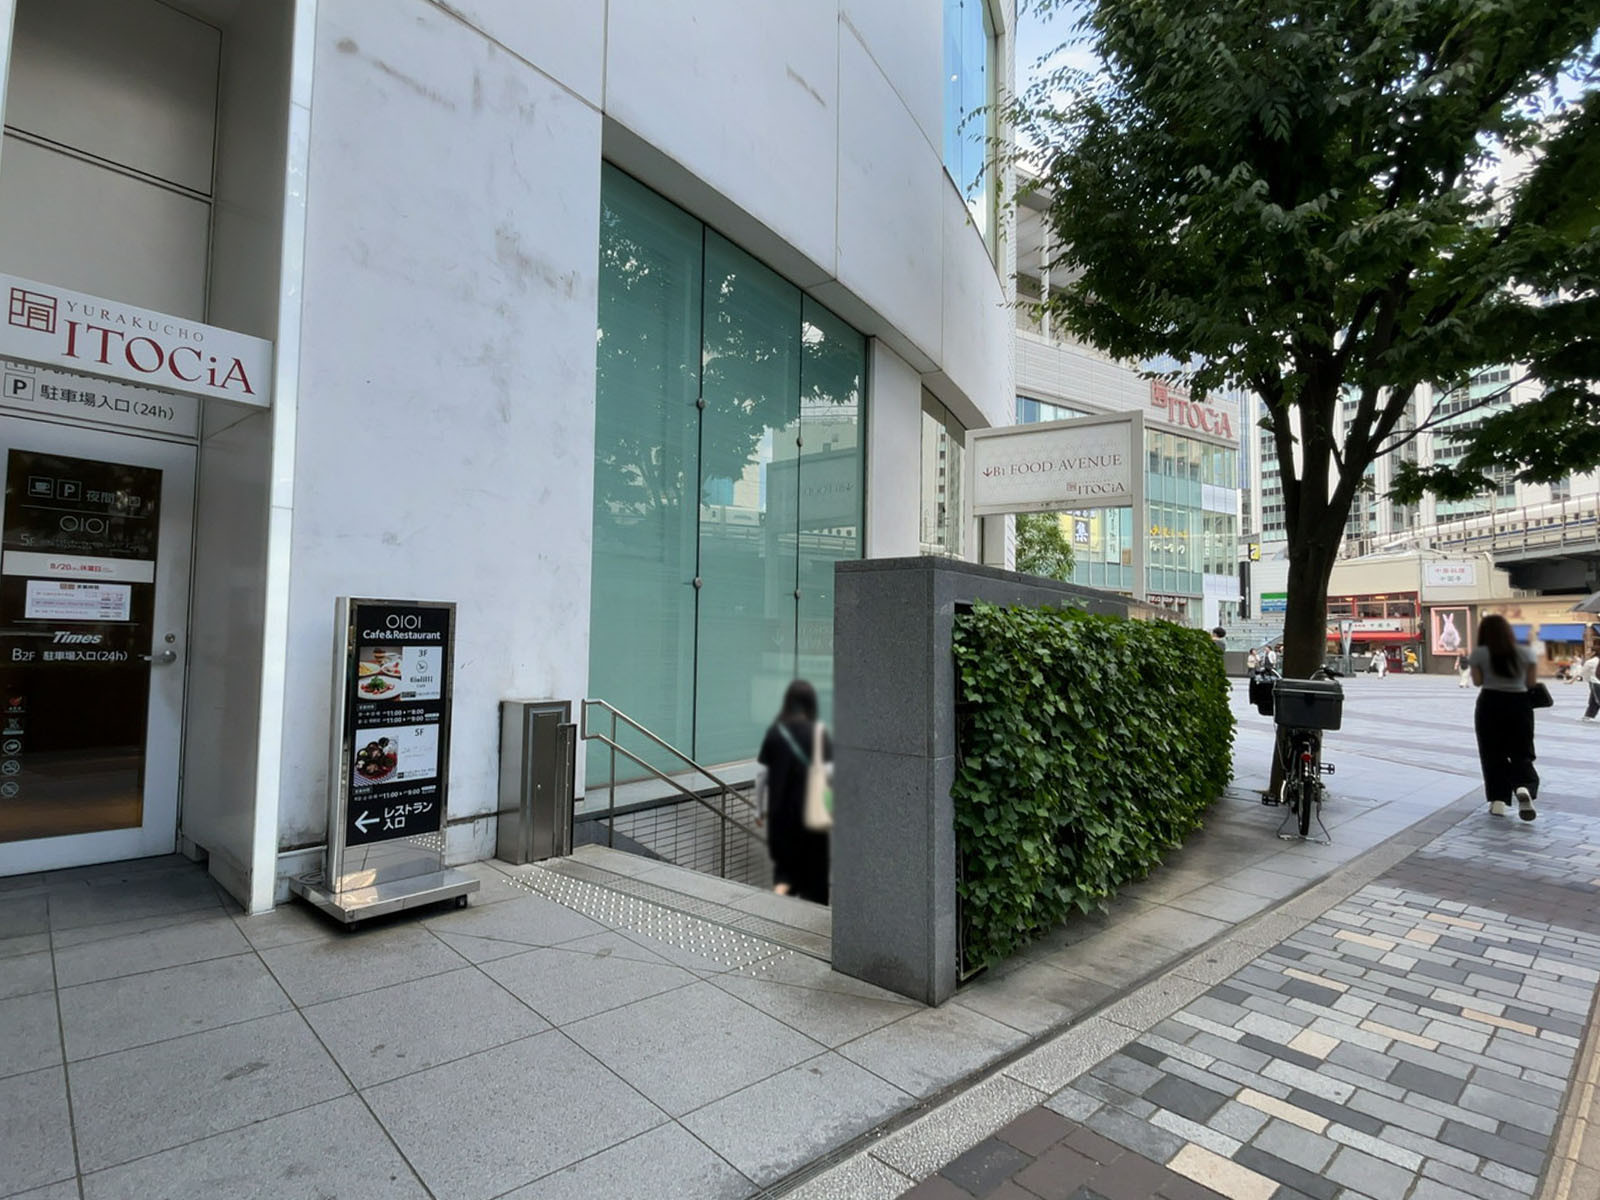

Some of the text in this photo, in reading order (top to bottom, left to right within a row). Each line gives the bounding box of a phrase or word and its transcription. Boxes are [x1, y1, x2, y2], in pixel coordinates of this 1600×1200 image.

[67, 301, 205, 342] YURAKUCHO
[13, 379, 28, 395] P
[41, 384, 175, 421] 駐車場入口(24h)
[1010, 461, 1054, 475] FOOD
[1058, 454, 1122, 472] AVENUE
[53, 631, 103, 644] Times
[363, 630, 441, 640] Cafe&Restaurant
[12, 648, 36, 661] B2F
[384, 802, 433, 818] レストラン
[383, 816, 405, 830] 入口
